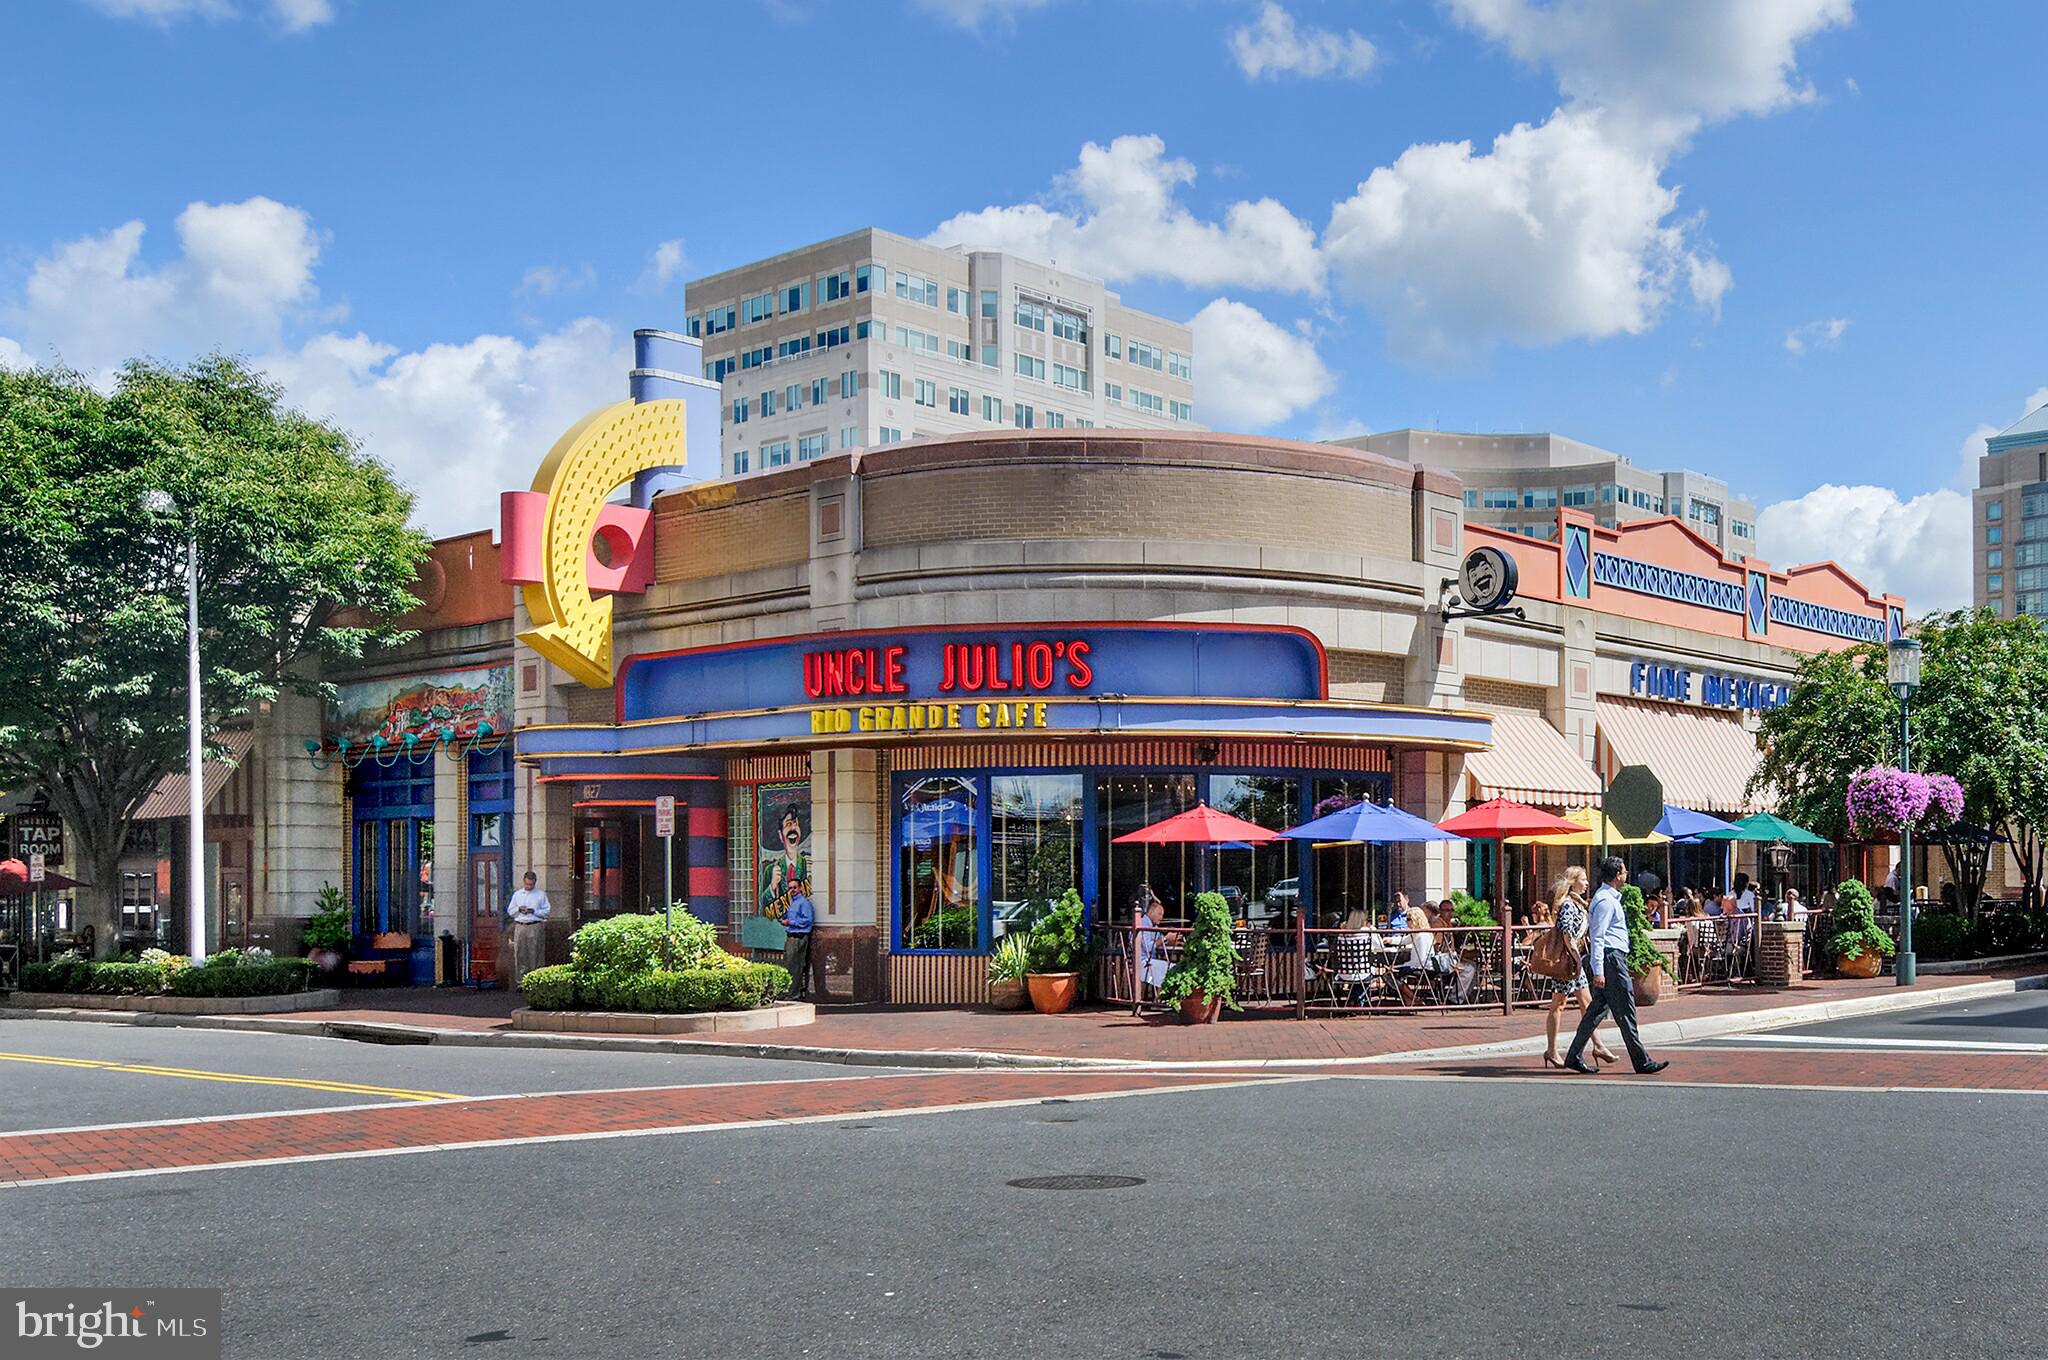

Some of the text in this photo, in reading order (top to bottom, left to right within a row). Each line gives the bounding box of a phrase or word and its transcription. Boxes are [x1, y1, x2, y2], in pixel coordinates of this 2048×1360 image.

[803, 640, 1093, 697] UNCLE JULIO'S
[1630, 662, 1793, 709] FINE MEXICA
[811, 703, 1047, 733] RIO GRANDE CAFE
[19, 827, 61, 841] TAP
[20, 843, 61, 855] ROOM
